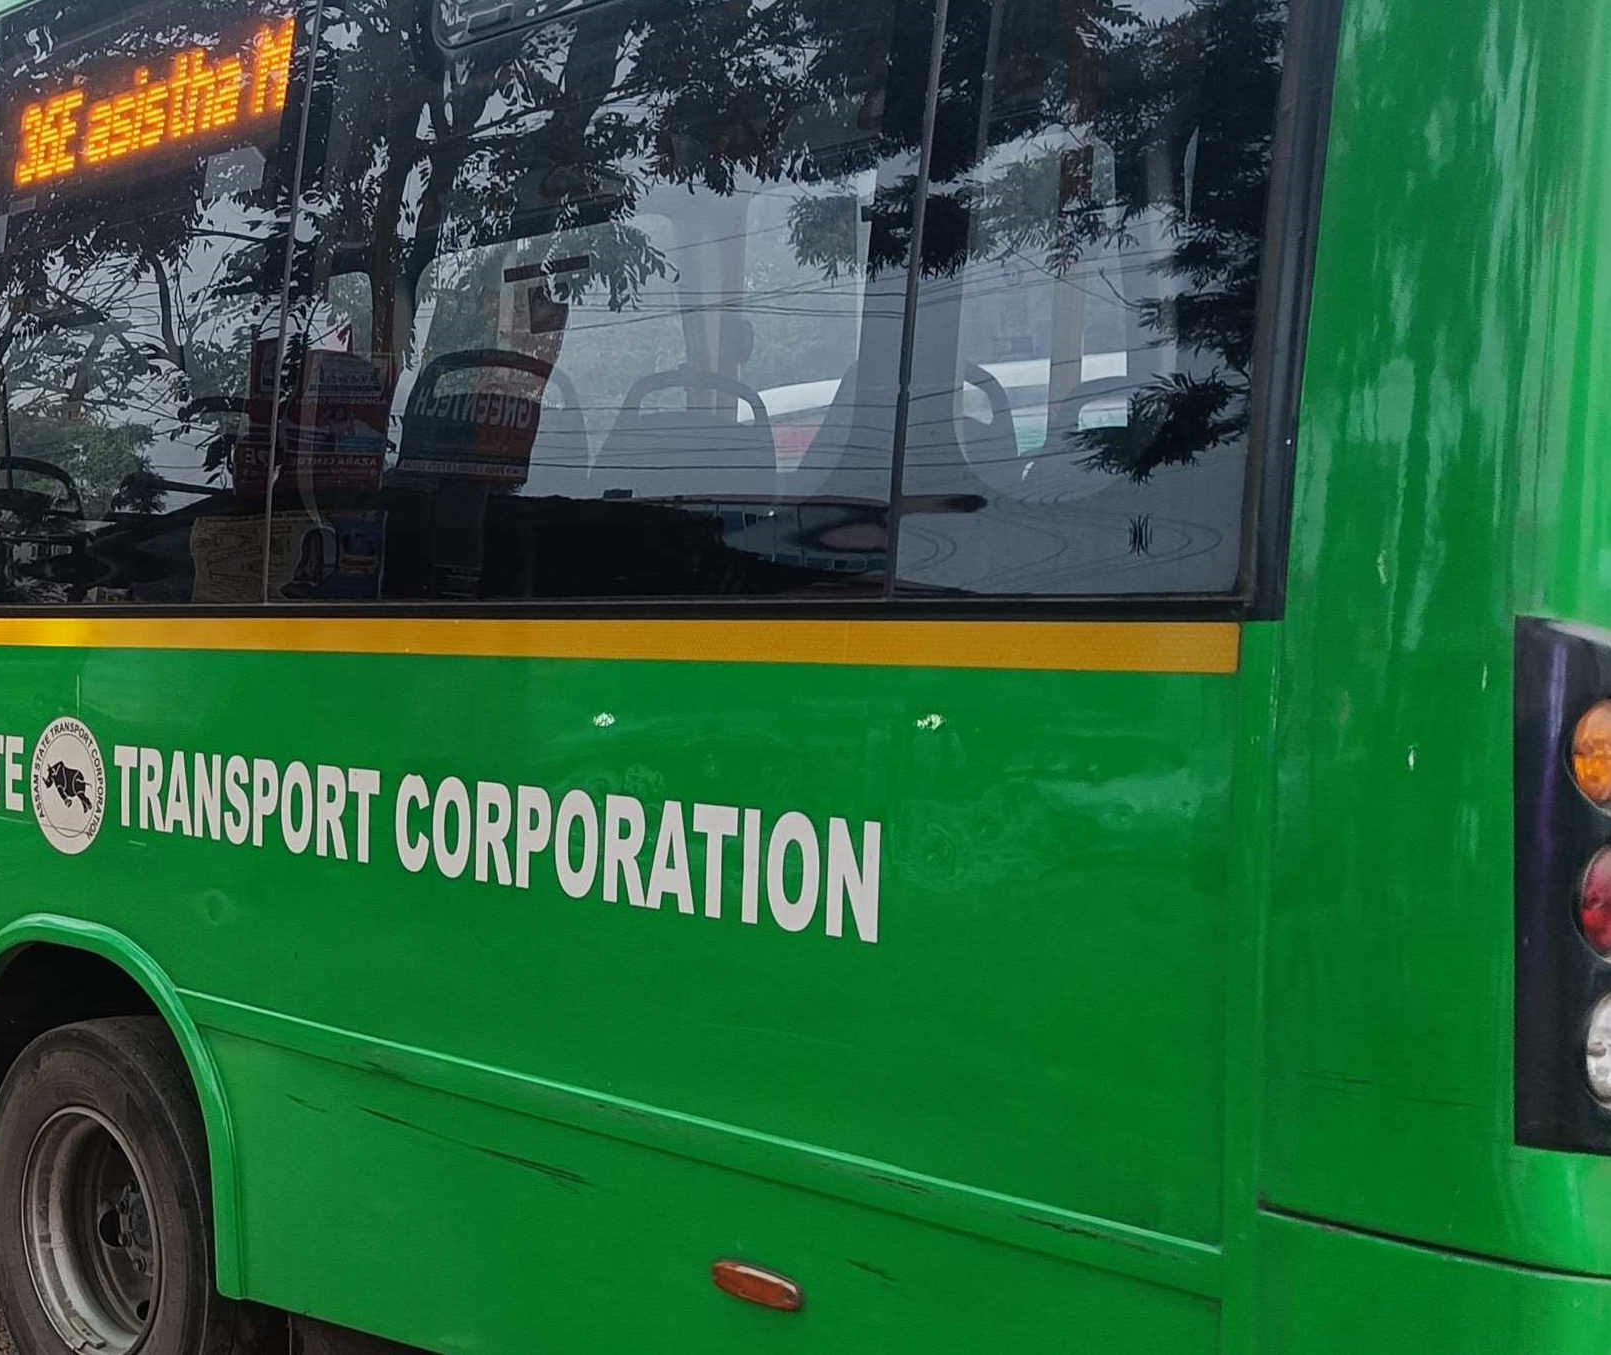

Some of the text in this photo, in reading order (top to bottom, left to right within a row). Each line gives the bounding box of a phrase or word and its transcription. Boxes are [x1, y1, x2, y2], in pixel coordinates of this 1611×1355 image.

[33, 722, 104, 840] ASSAM STATE TRANSPORT CORPORATION
[114, 746, 381, 864] TRANSPORT
[394, 771, 882, 943] CORPORATION
